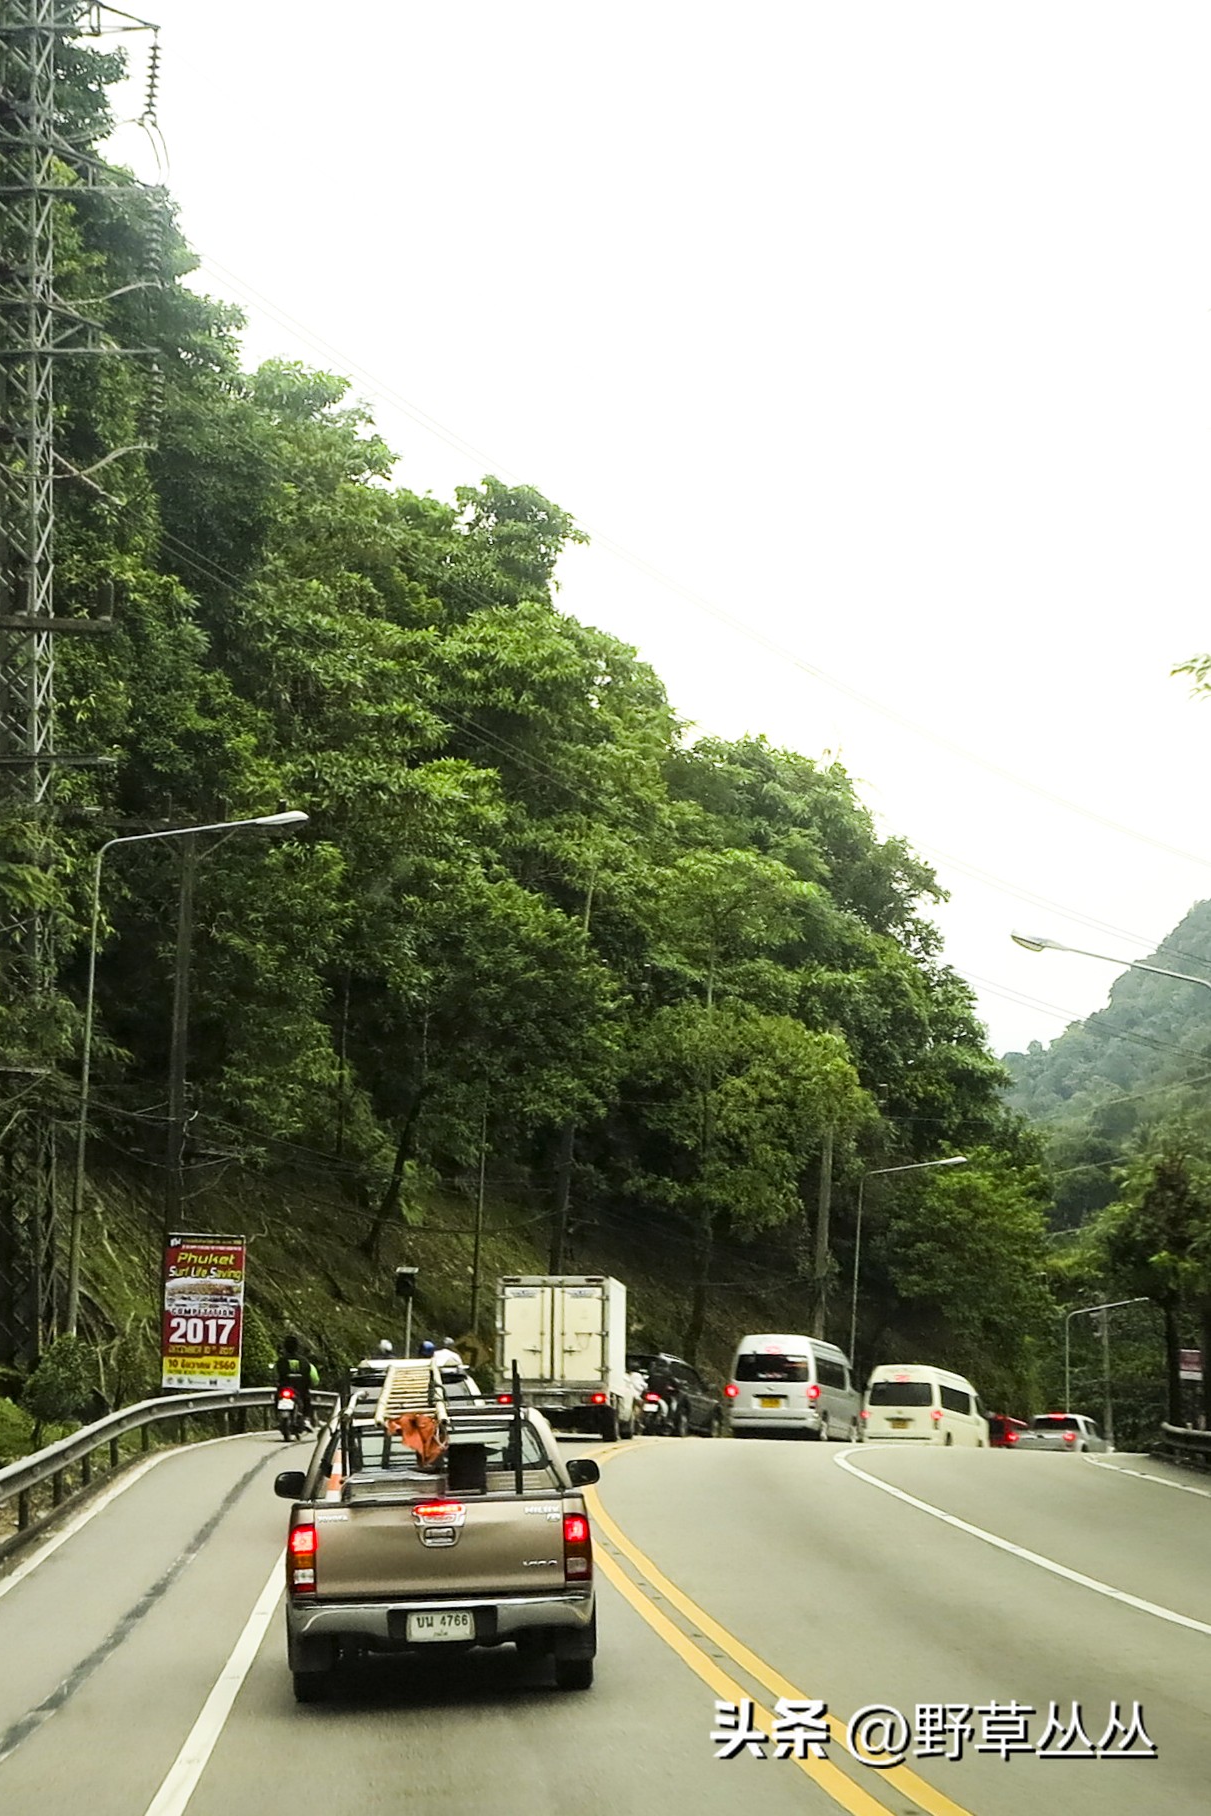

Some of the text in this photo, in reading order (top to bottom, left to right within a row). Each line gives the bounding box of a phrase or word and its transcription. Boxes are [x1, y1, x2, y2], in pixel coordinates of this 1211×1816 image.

[177, 1252, 236, 1265] Phuket
[169, 1265, 189, 1277] Surf
[209, 1266, 242, 1283] Saving
[169, 1317, 236, 1344] 2017
[168, 1359, 179, 1368] 10
[213, 1360, 236, 1370] 2560
[440, 1614, 469, 1627] 4766
